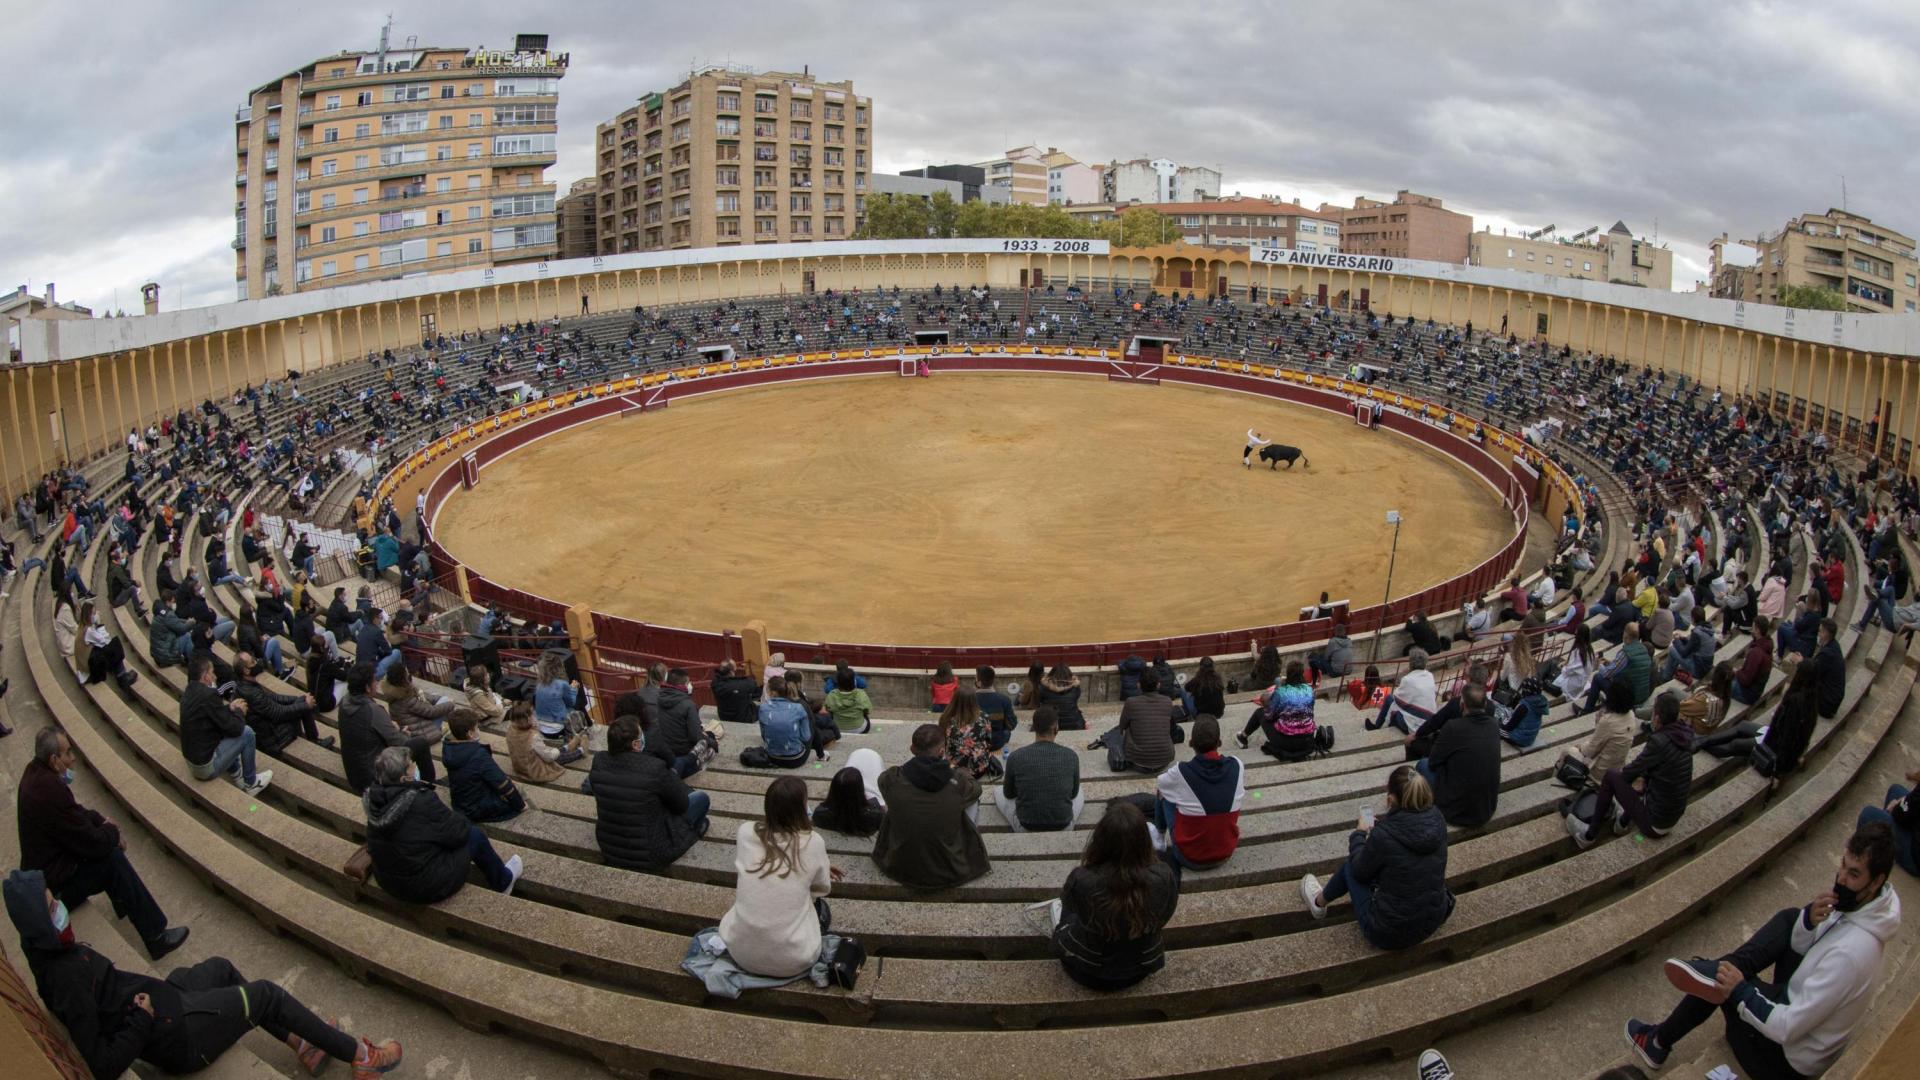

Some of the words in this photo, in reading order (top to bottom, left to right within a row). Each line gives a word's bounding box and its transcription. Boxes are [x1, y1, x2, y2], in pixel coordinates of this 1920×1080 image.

[474, 48, 557, 67] HOSTAL
[478, 66, 558, 75] RESTAURANTE
[1003, 240, 1038, 252] 1933
[1053, 240, 1090, 252] 2008
[1288, 252, 1394, 272] ANIVERSARIO
